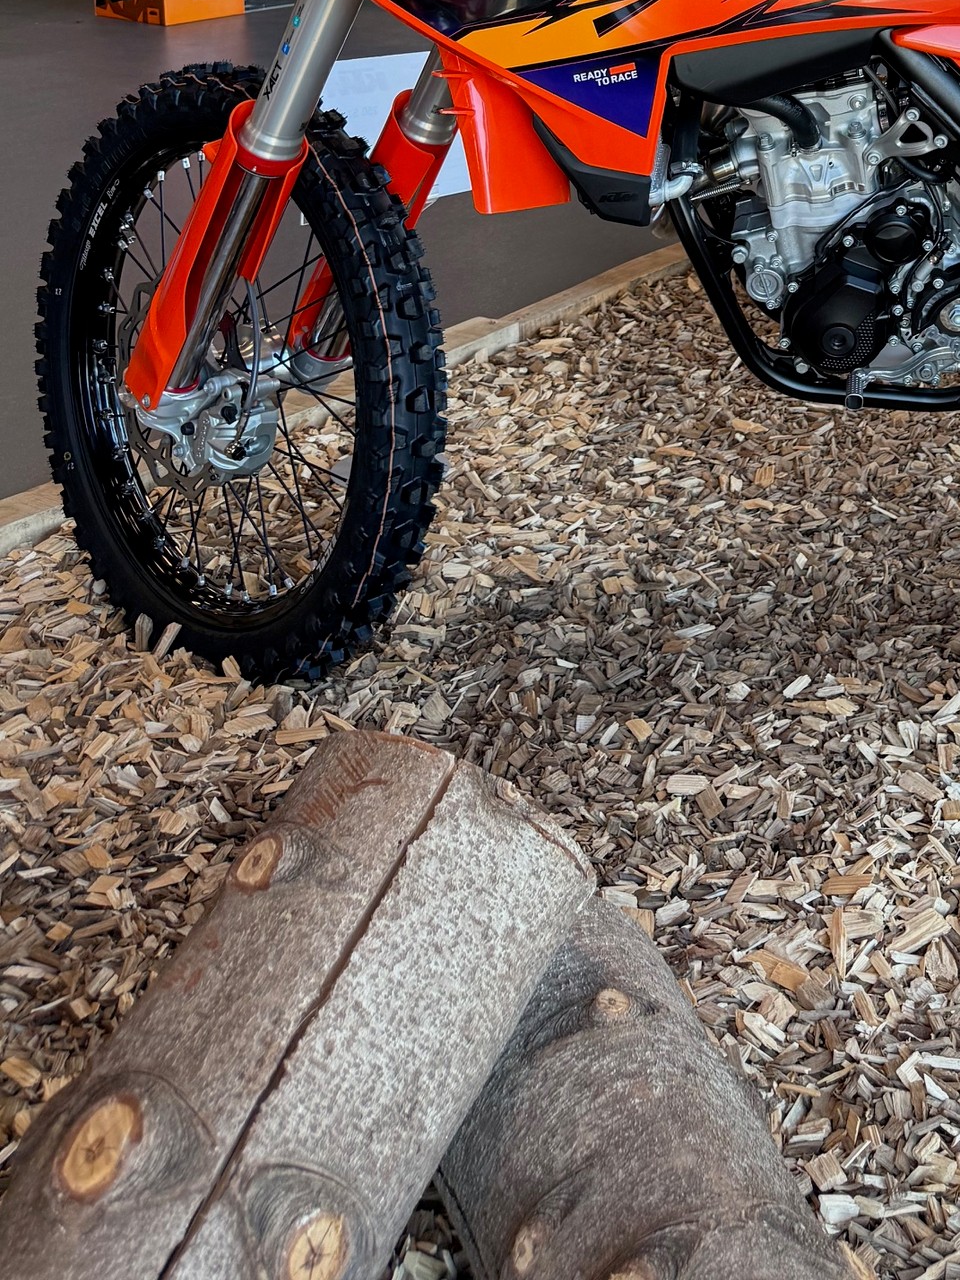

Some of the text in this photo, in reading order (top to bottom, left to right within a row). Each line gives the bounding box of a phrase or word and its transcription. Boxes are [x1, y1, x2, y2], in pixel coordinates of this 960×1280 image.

[263, 60, 282, 101] XACT
[573, 68, 607, 82] READY
[595, 70, 638, 86] TO RACE
[88, 201, 108, 239] EXCEL
